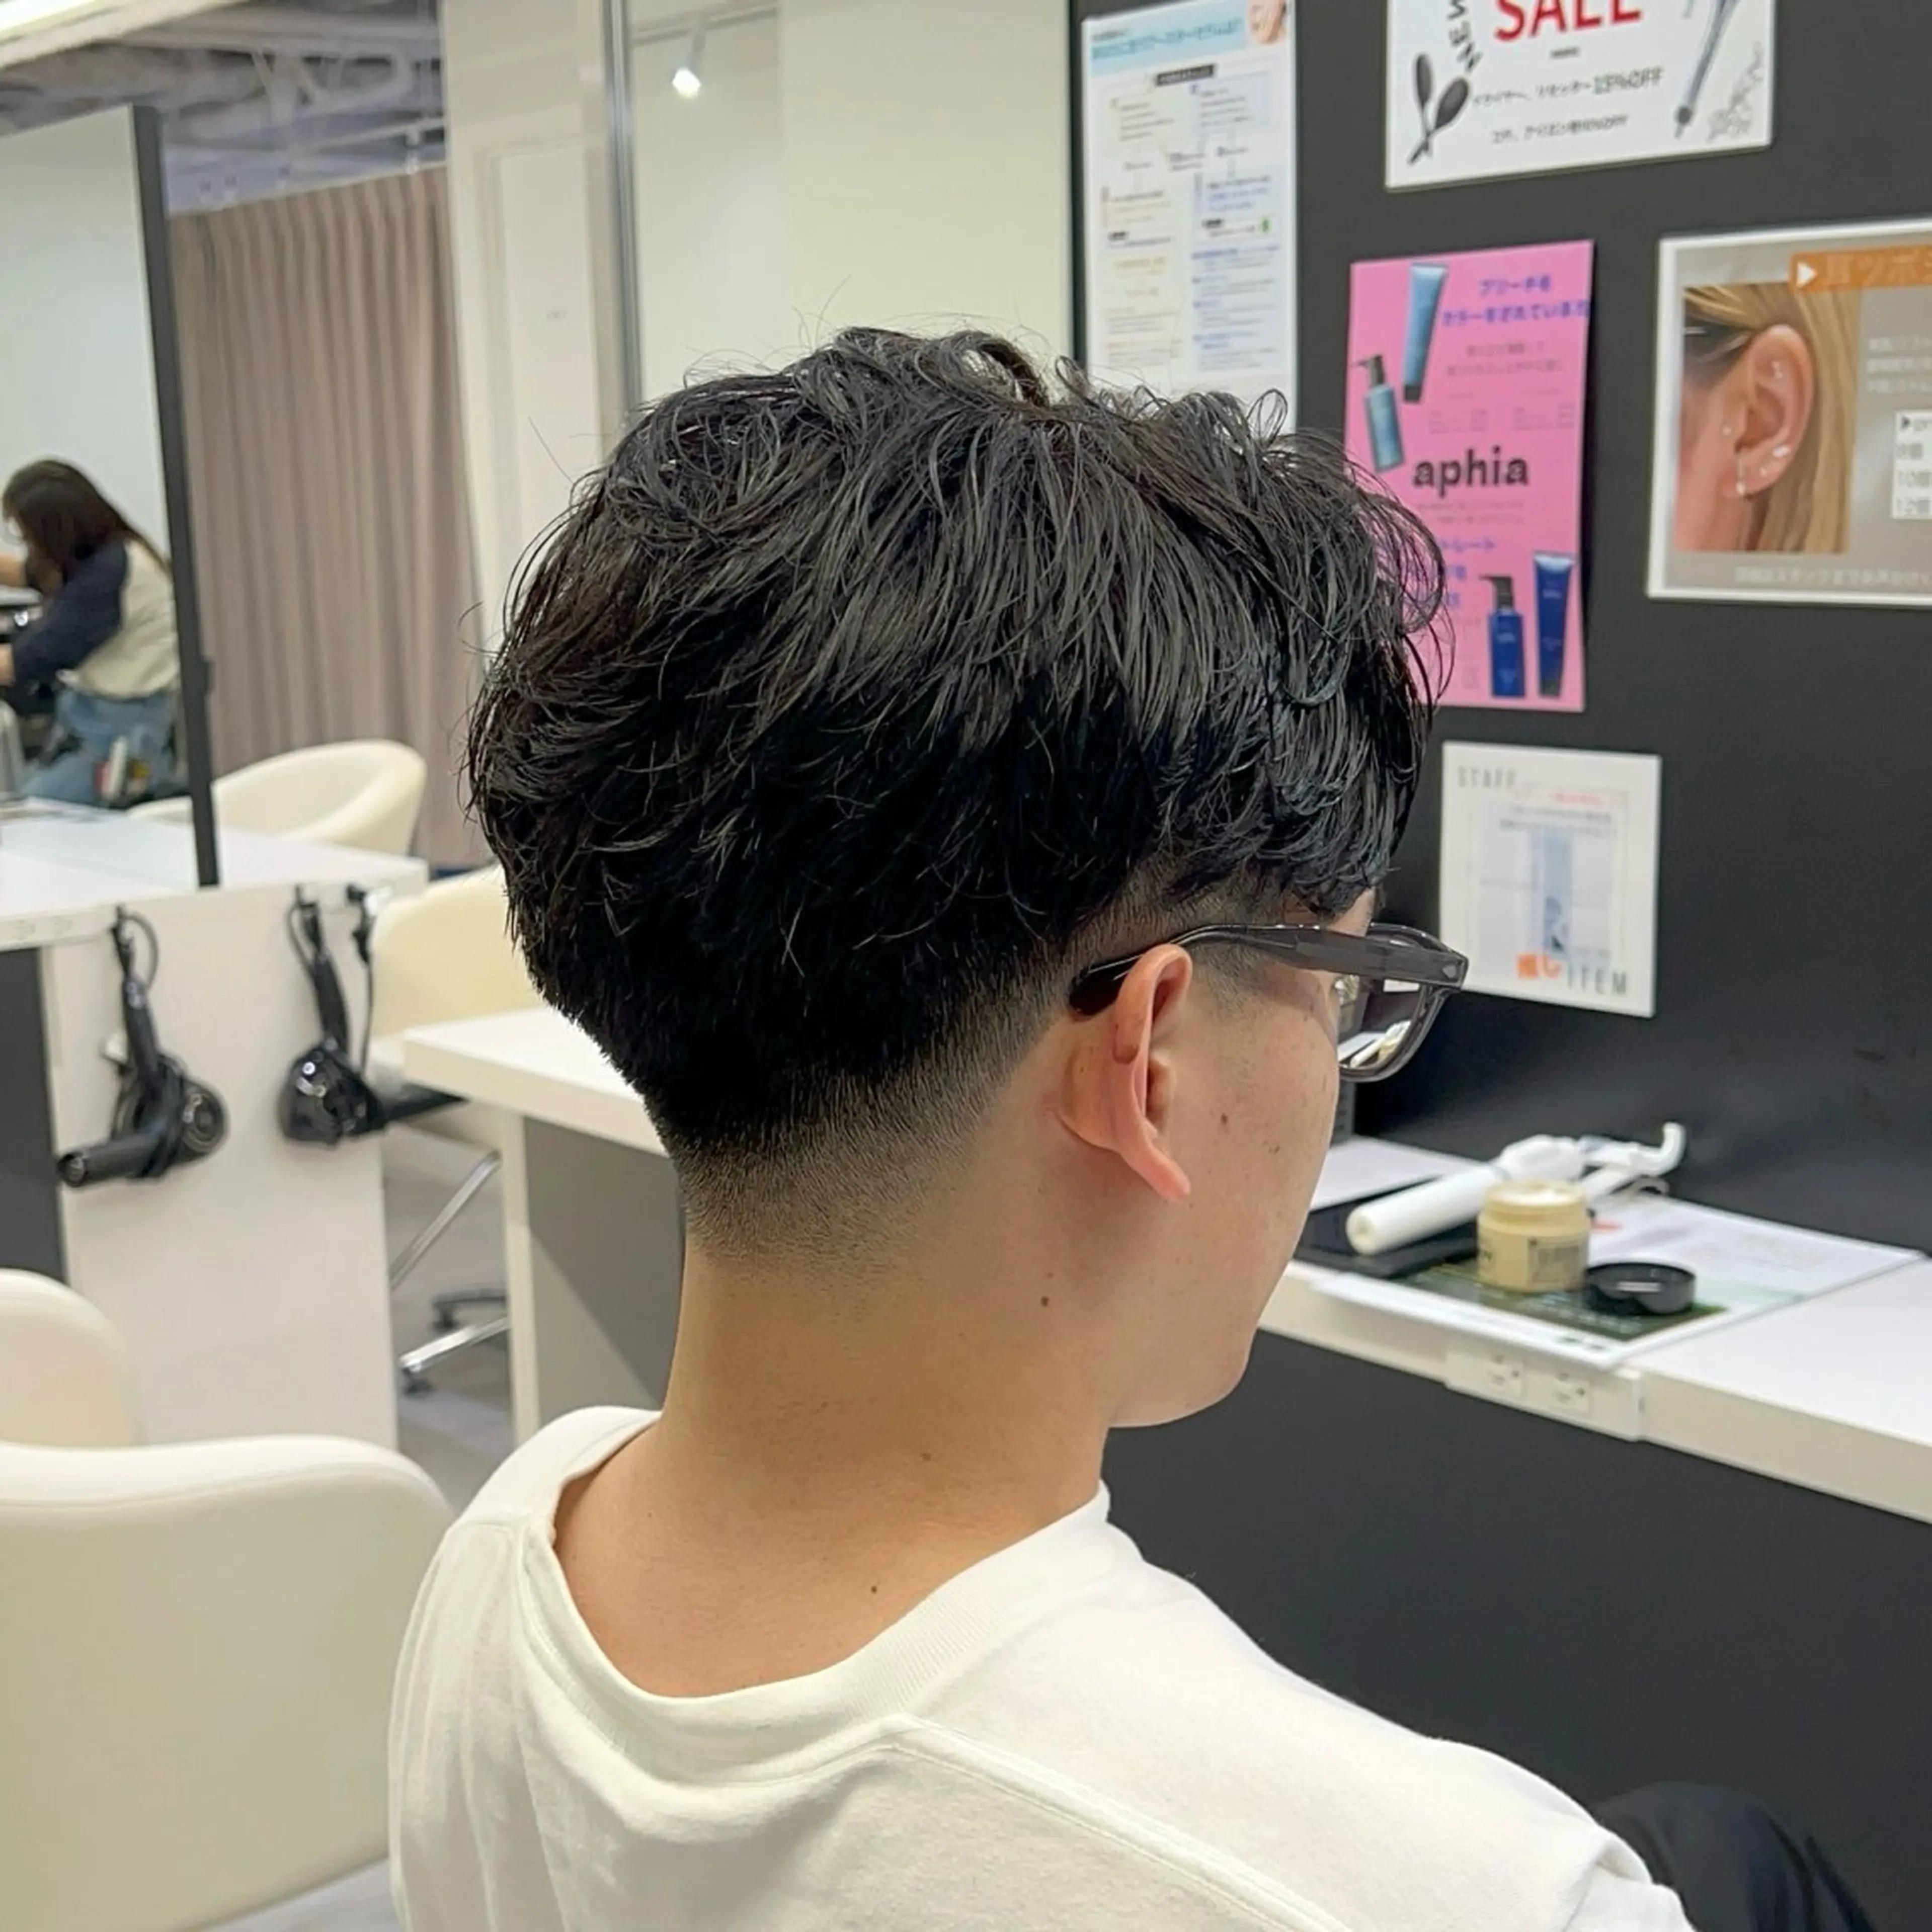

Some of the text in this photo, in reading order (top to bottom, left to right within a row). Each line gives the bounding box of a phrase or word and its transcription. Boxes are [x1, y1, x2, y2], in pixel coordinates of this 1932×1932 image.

[1413, 444, 1529, 498] aphia
[1457, 764, 1518, 789] STAFF
[1567, 963, 1627, 997] ITEM
